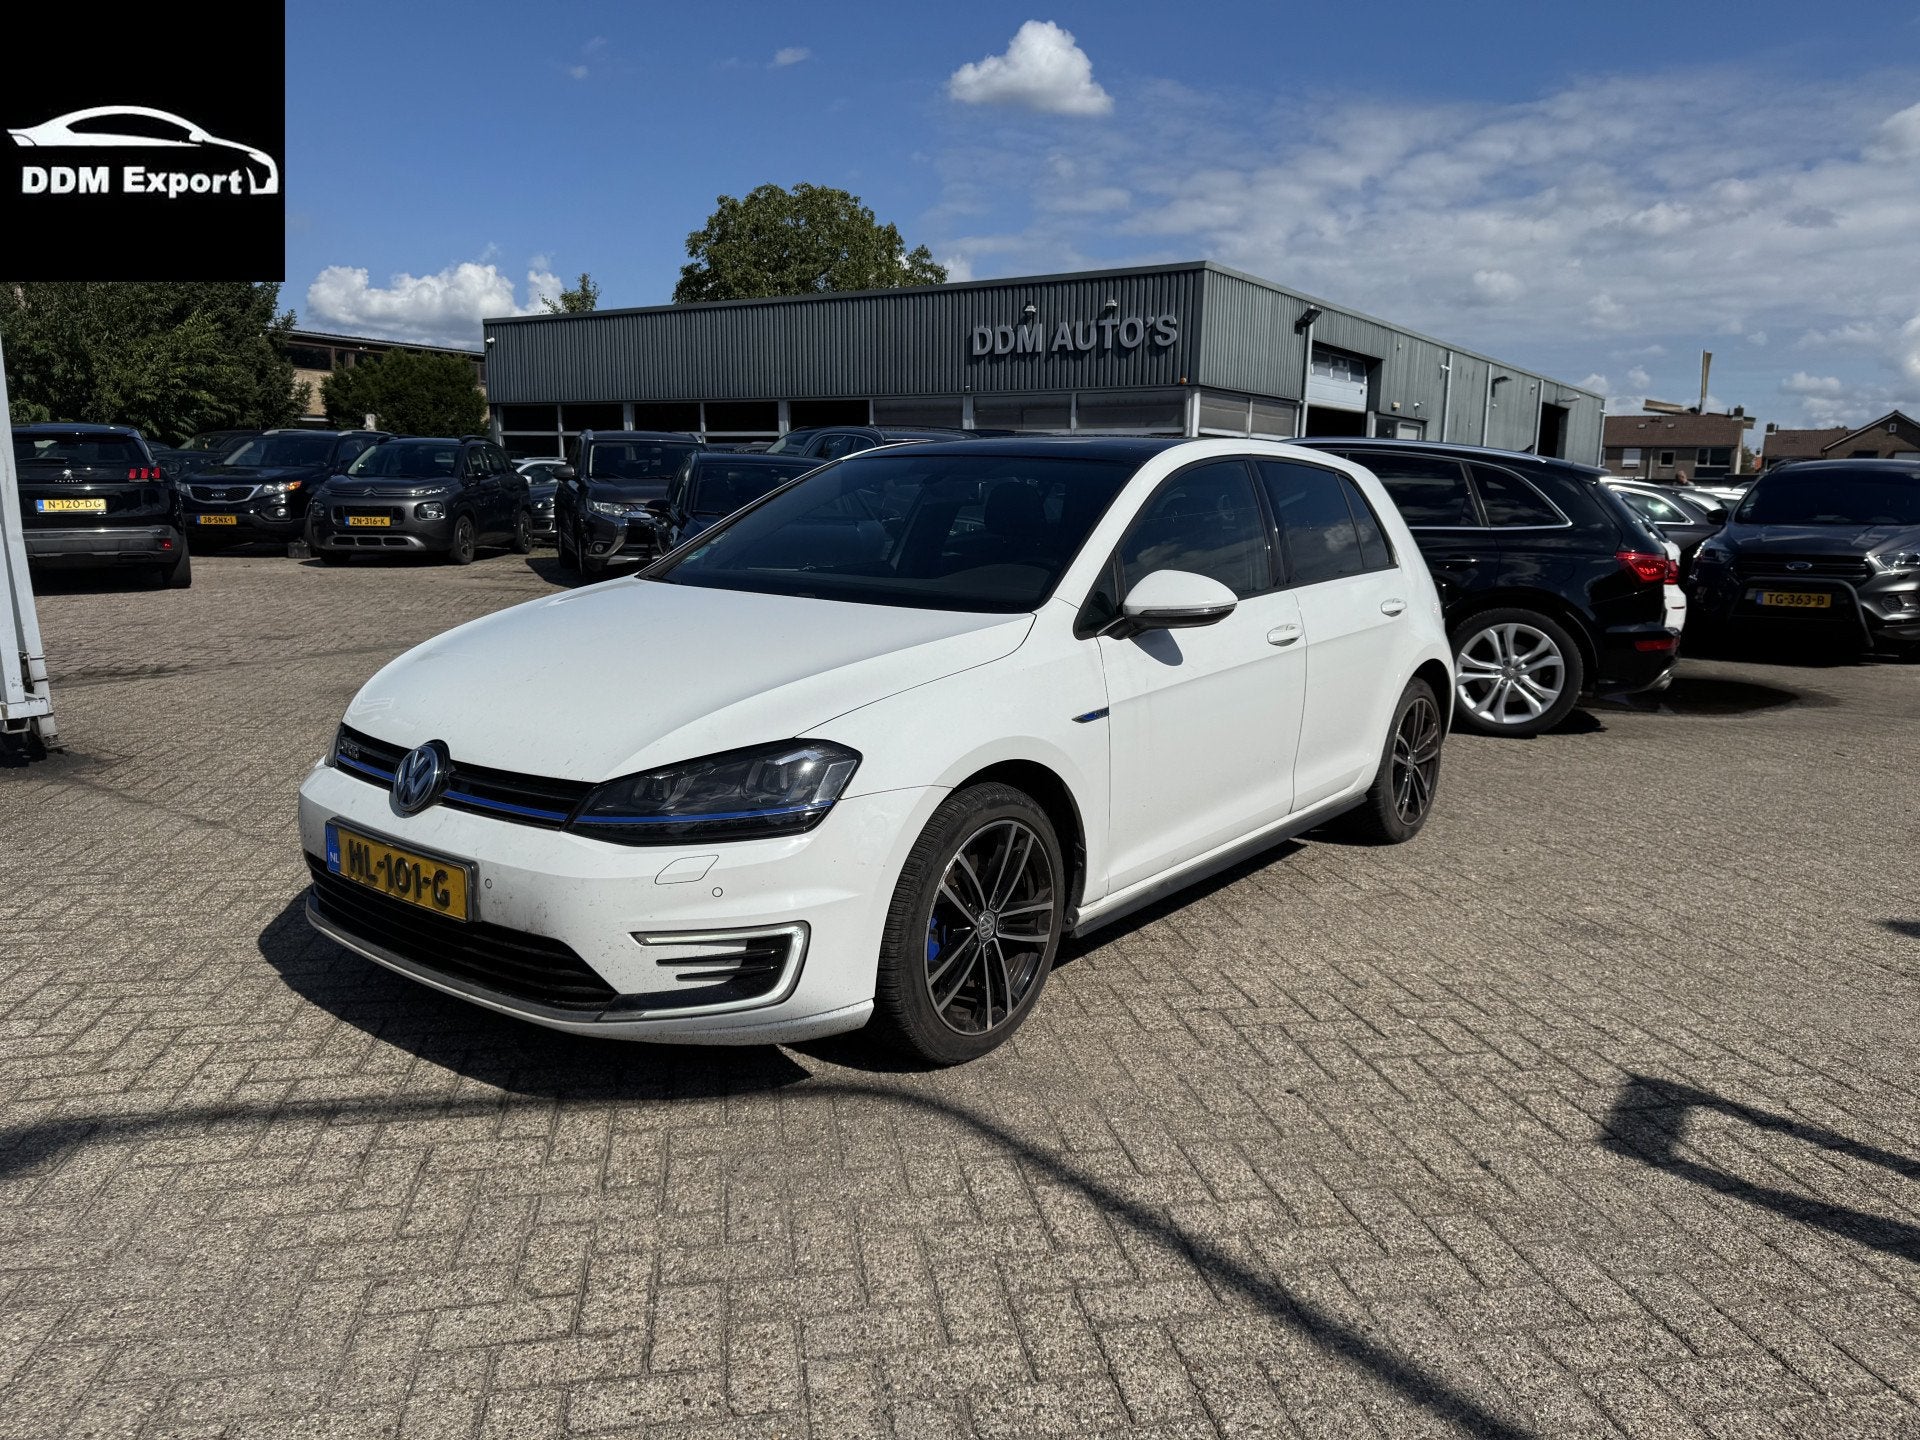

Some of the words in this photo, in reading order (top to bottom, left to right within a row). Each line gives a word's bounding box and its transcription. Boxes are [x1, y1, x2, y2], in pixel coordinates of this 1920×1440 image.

[972, 323, 1043, 356] DDM
[1051, 314, 1178, 352] AUTO'S
[48, 500, 101, 509] N-120-DG
[352, 517, 386, 525] ZN-316-K
[1767, 594, 1825, 606] TG-363-B
[329, 851, 340, 864] NL
[348, 838, 451, 908] HL-101-G
